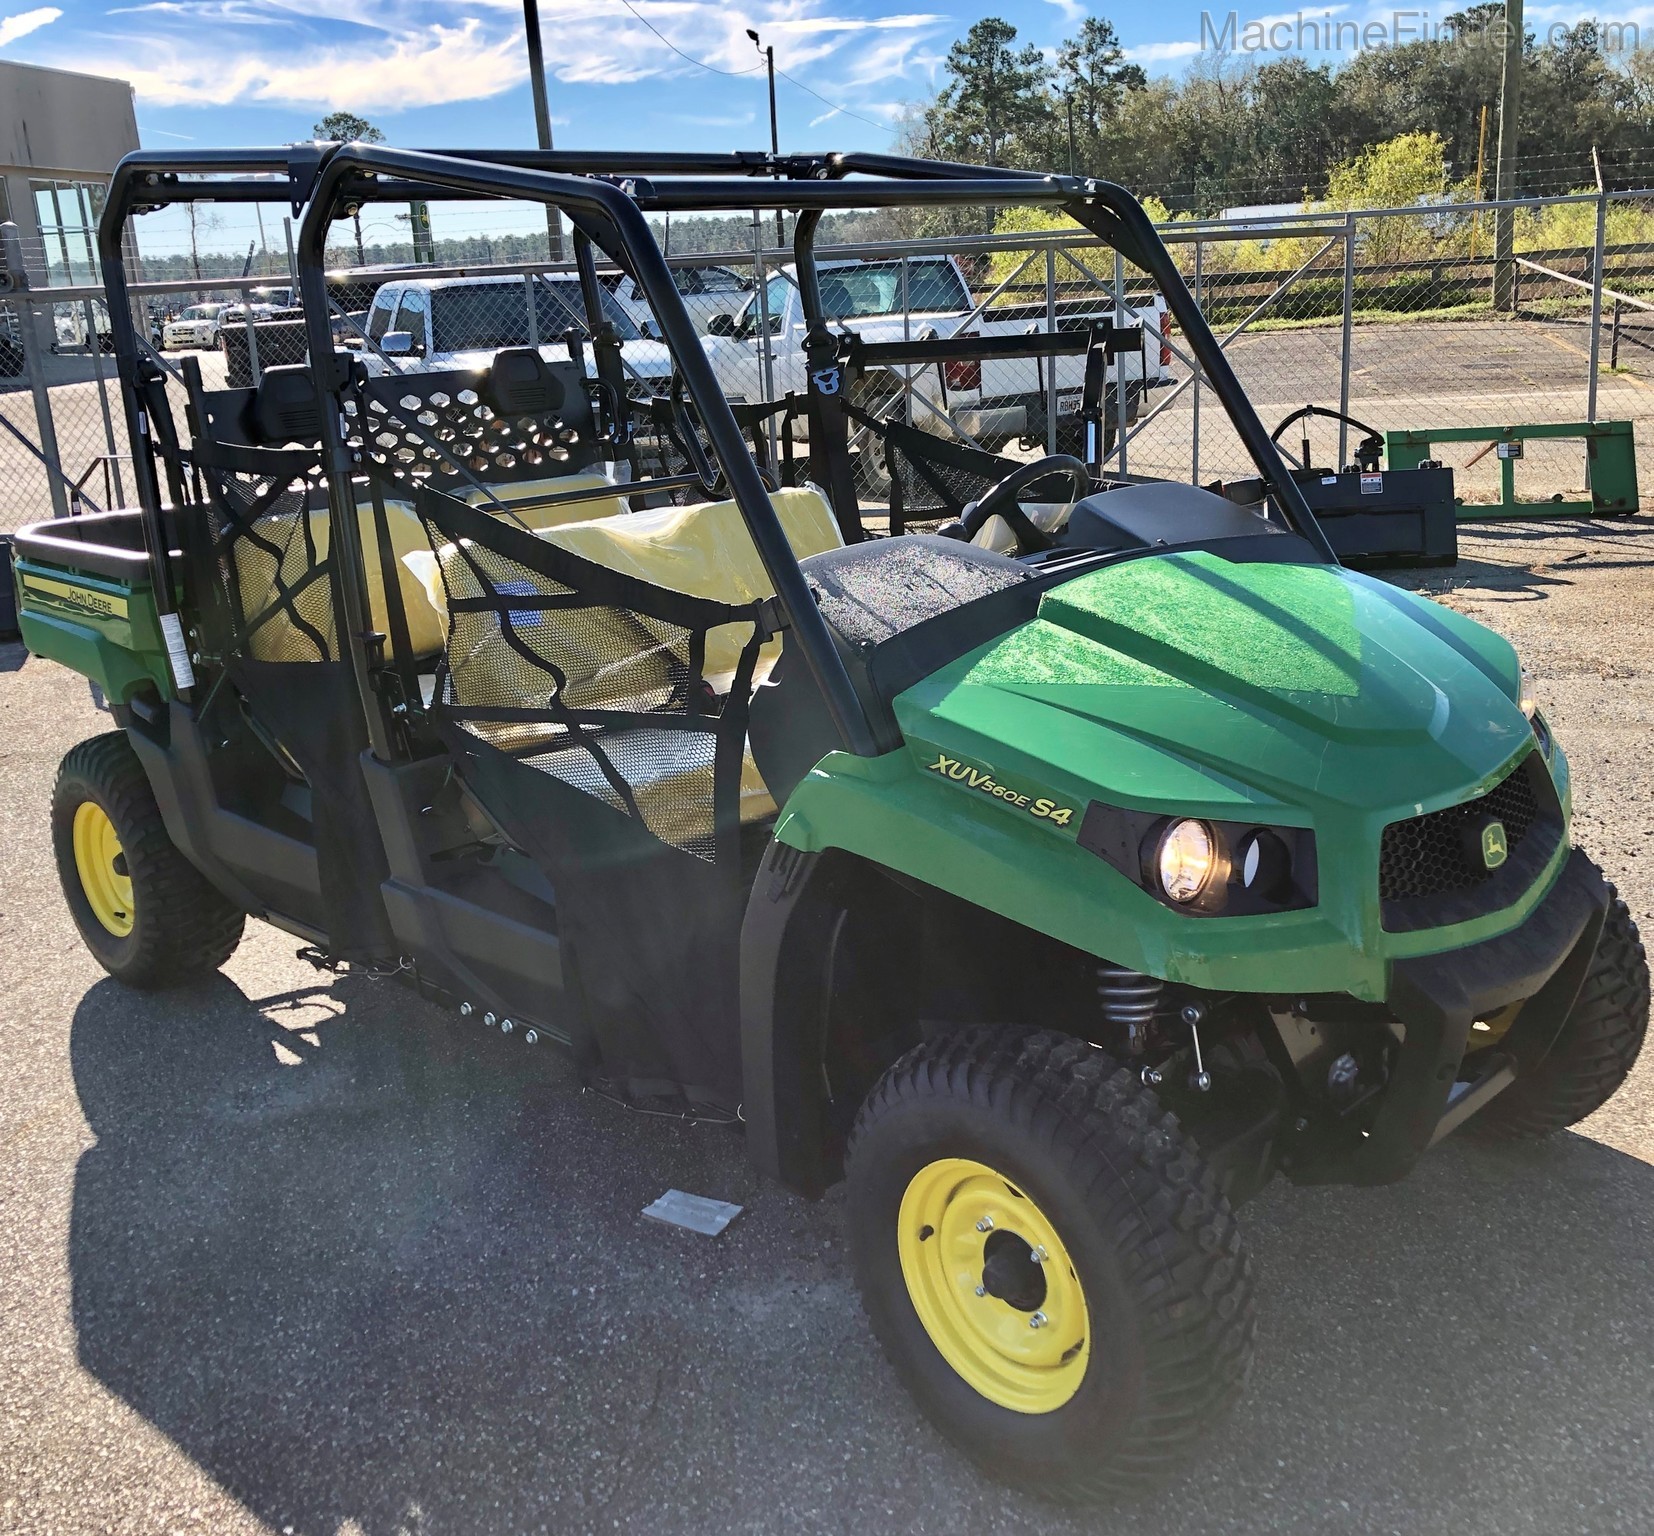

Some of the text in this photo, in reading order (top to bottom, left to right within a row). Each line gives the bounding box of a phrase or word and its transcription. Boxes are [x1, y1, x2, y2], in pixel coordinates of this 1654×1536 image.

[67, 587, 113, 614] JOHN DEERE
[929, 753, 1074, 826] XUV560E S4
